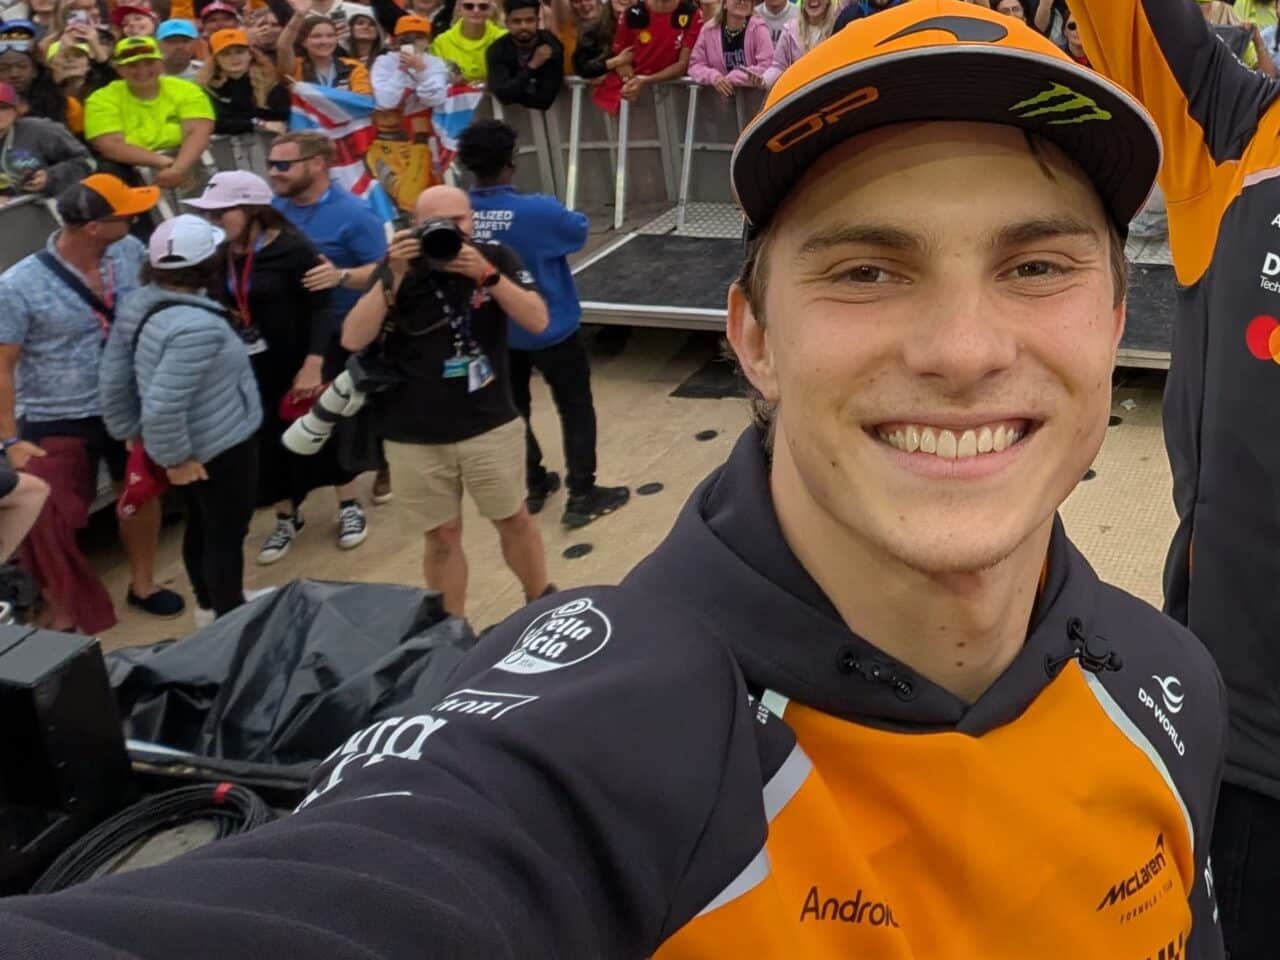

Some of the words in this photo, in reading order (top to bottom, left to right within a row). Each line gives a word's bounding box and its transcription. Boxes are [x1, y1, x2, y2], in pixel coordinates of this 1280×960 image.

[474, 221, 512, 231] SAFETY
[1138, 687, 1154, 709] DP
[1154, 704, 1185, 756] WORLD
[1096, 852, 1166, 913] McLaren
